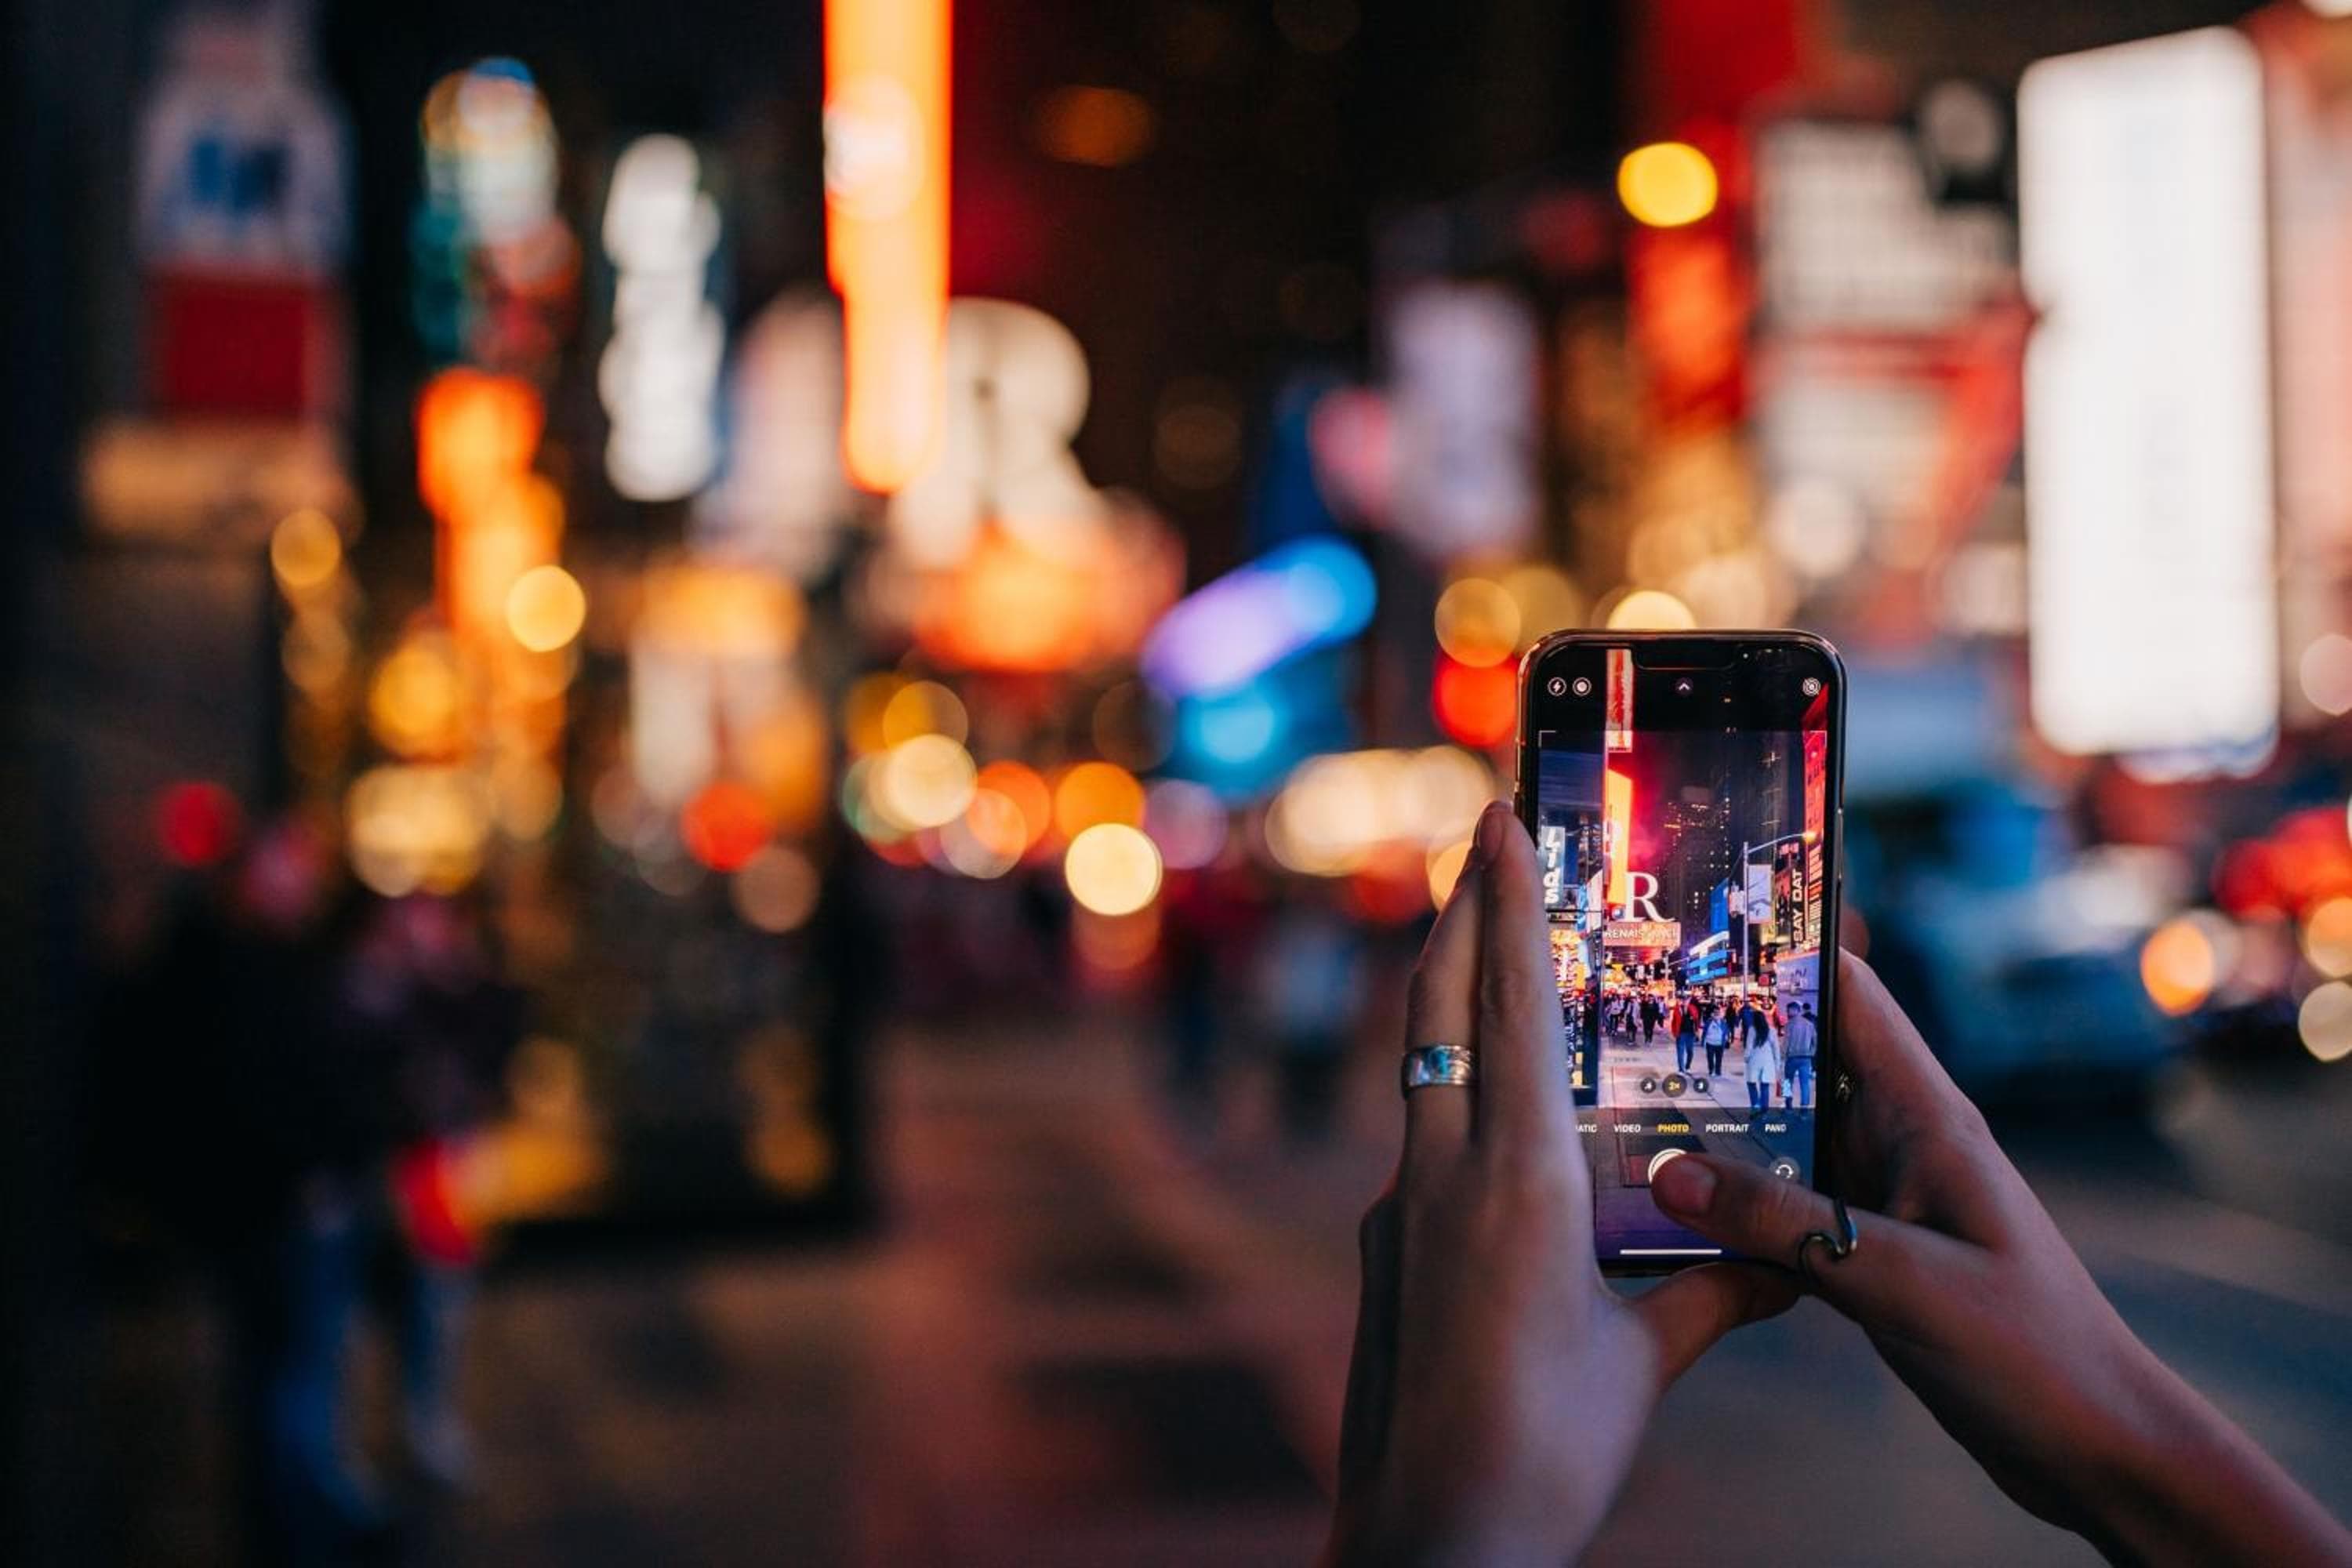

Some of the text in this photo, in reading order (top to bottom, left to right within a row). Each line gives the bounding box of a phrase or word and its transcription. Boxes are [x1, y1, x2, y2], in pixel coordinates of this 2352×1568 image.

[1621, 871, 1675, 923] R
[1604, 927, 1676, 940] RENAISANE
[1576, 1123, 1787, 1134] ATIC VIDEO PHOTO PORTRAIT PANO
